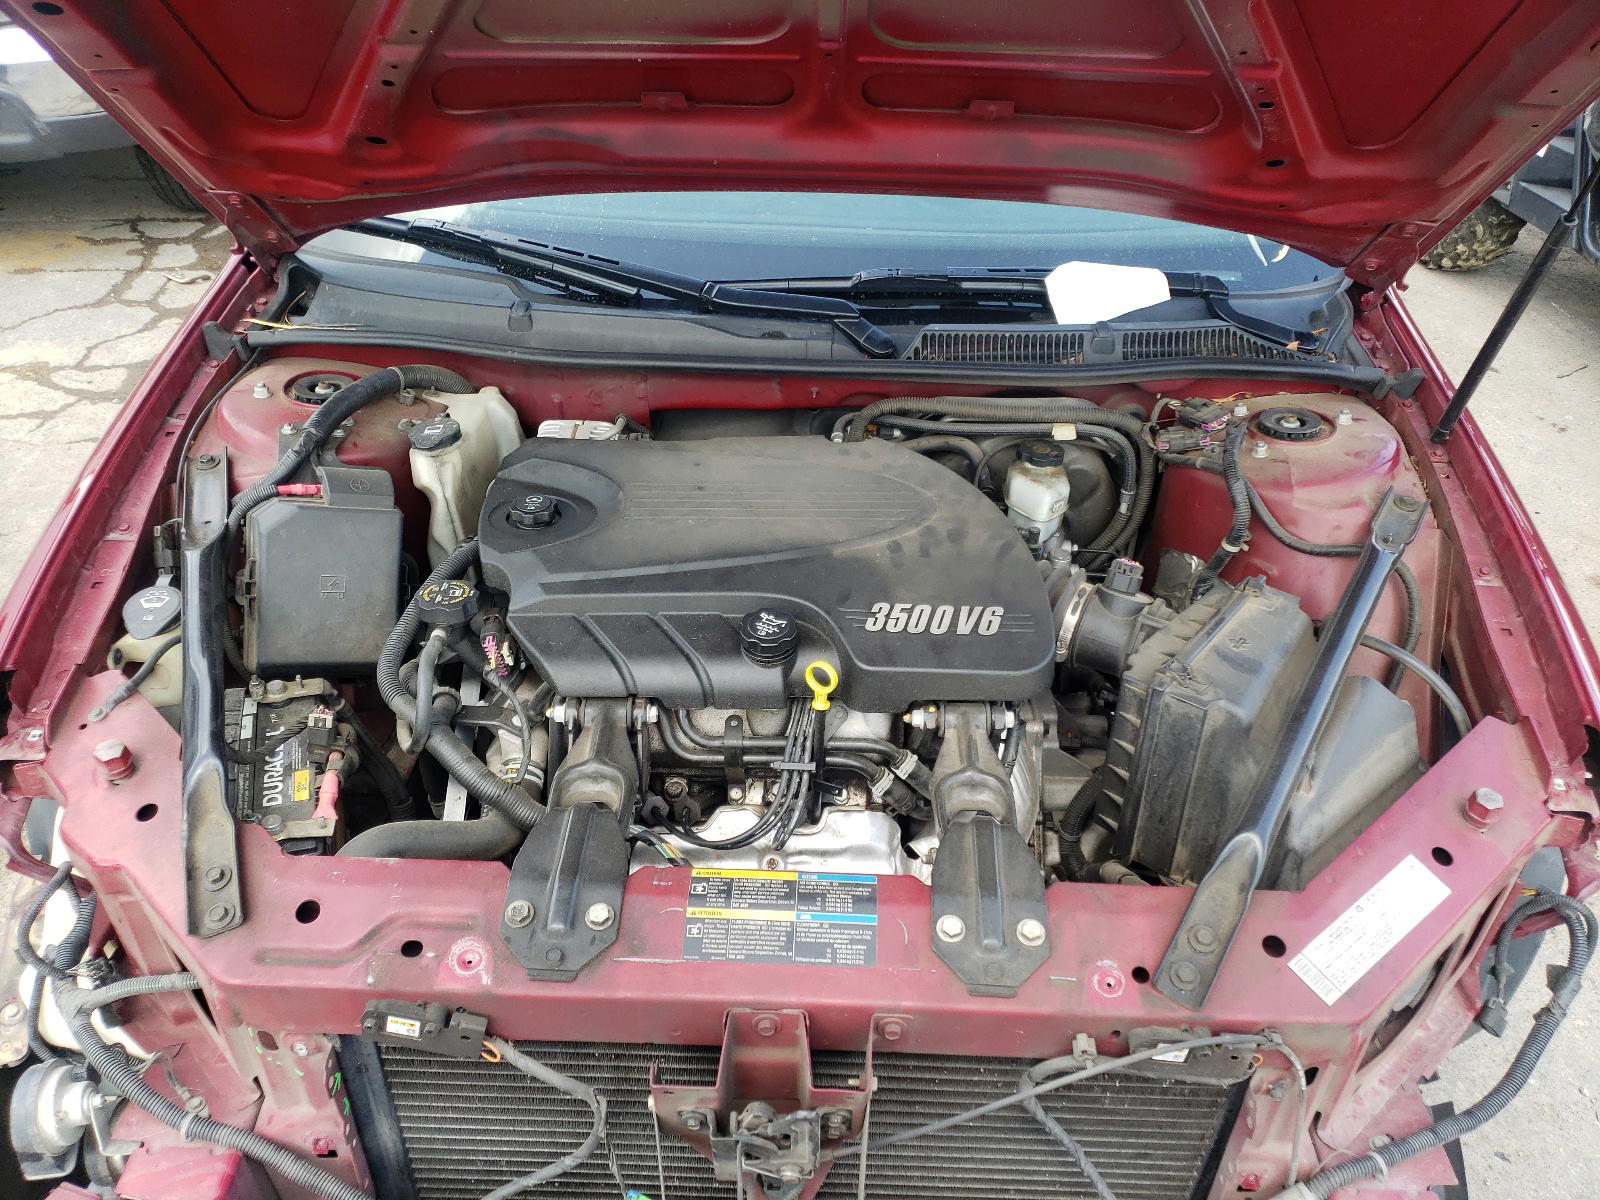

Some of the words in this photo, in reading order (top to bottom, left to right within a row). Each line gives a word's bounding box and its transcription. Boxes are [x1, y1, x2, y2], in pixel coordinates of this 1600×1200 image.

[864, 602, 954, 635] 3500
[956, 605, 1005, 636] V6
[263, 726, 285, 807] DURACL
